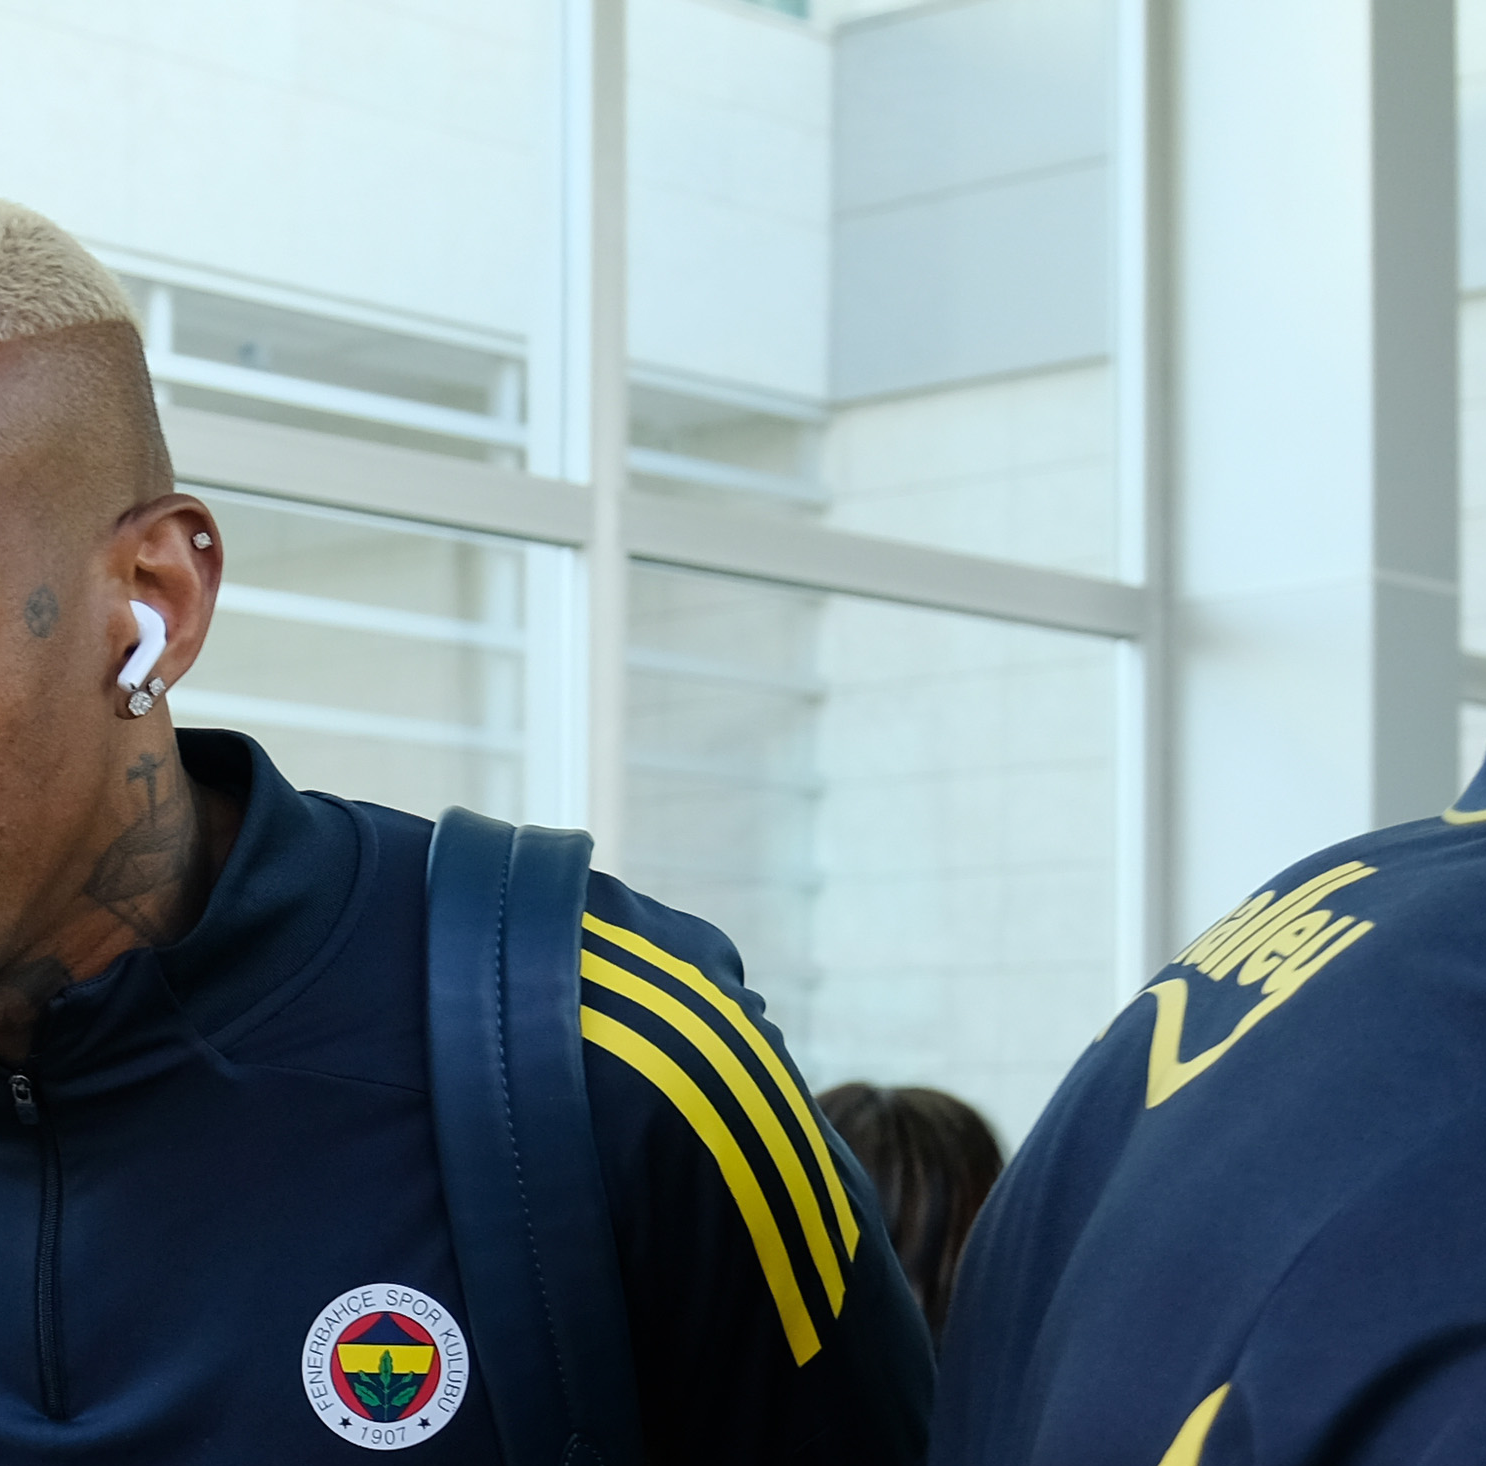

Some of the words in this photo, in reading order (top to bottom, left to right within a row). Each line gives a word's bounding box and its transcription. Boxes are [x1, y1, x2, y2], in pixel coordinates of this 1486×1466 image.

[306, 1290, 376, 1412] FENERBAHÇE
[385, 1289, 442, 1327] SPOR
[437, 1327, 467, 1413] KULÜBÜ
[361, 1426, 406, 1445] 1907
